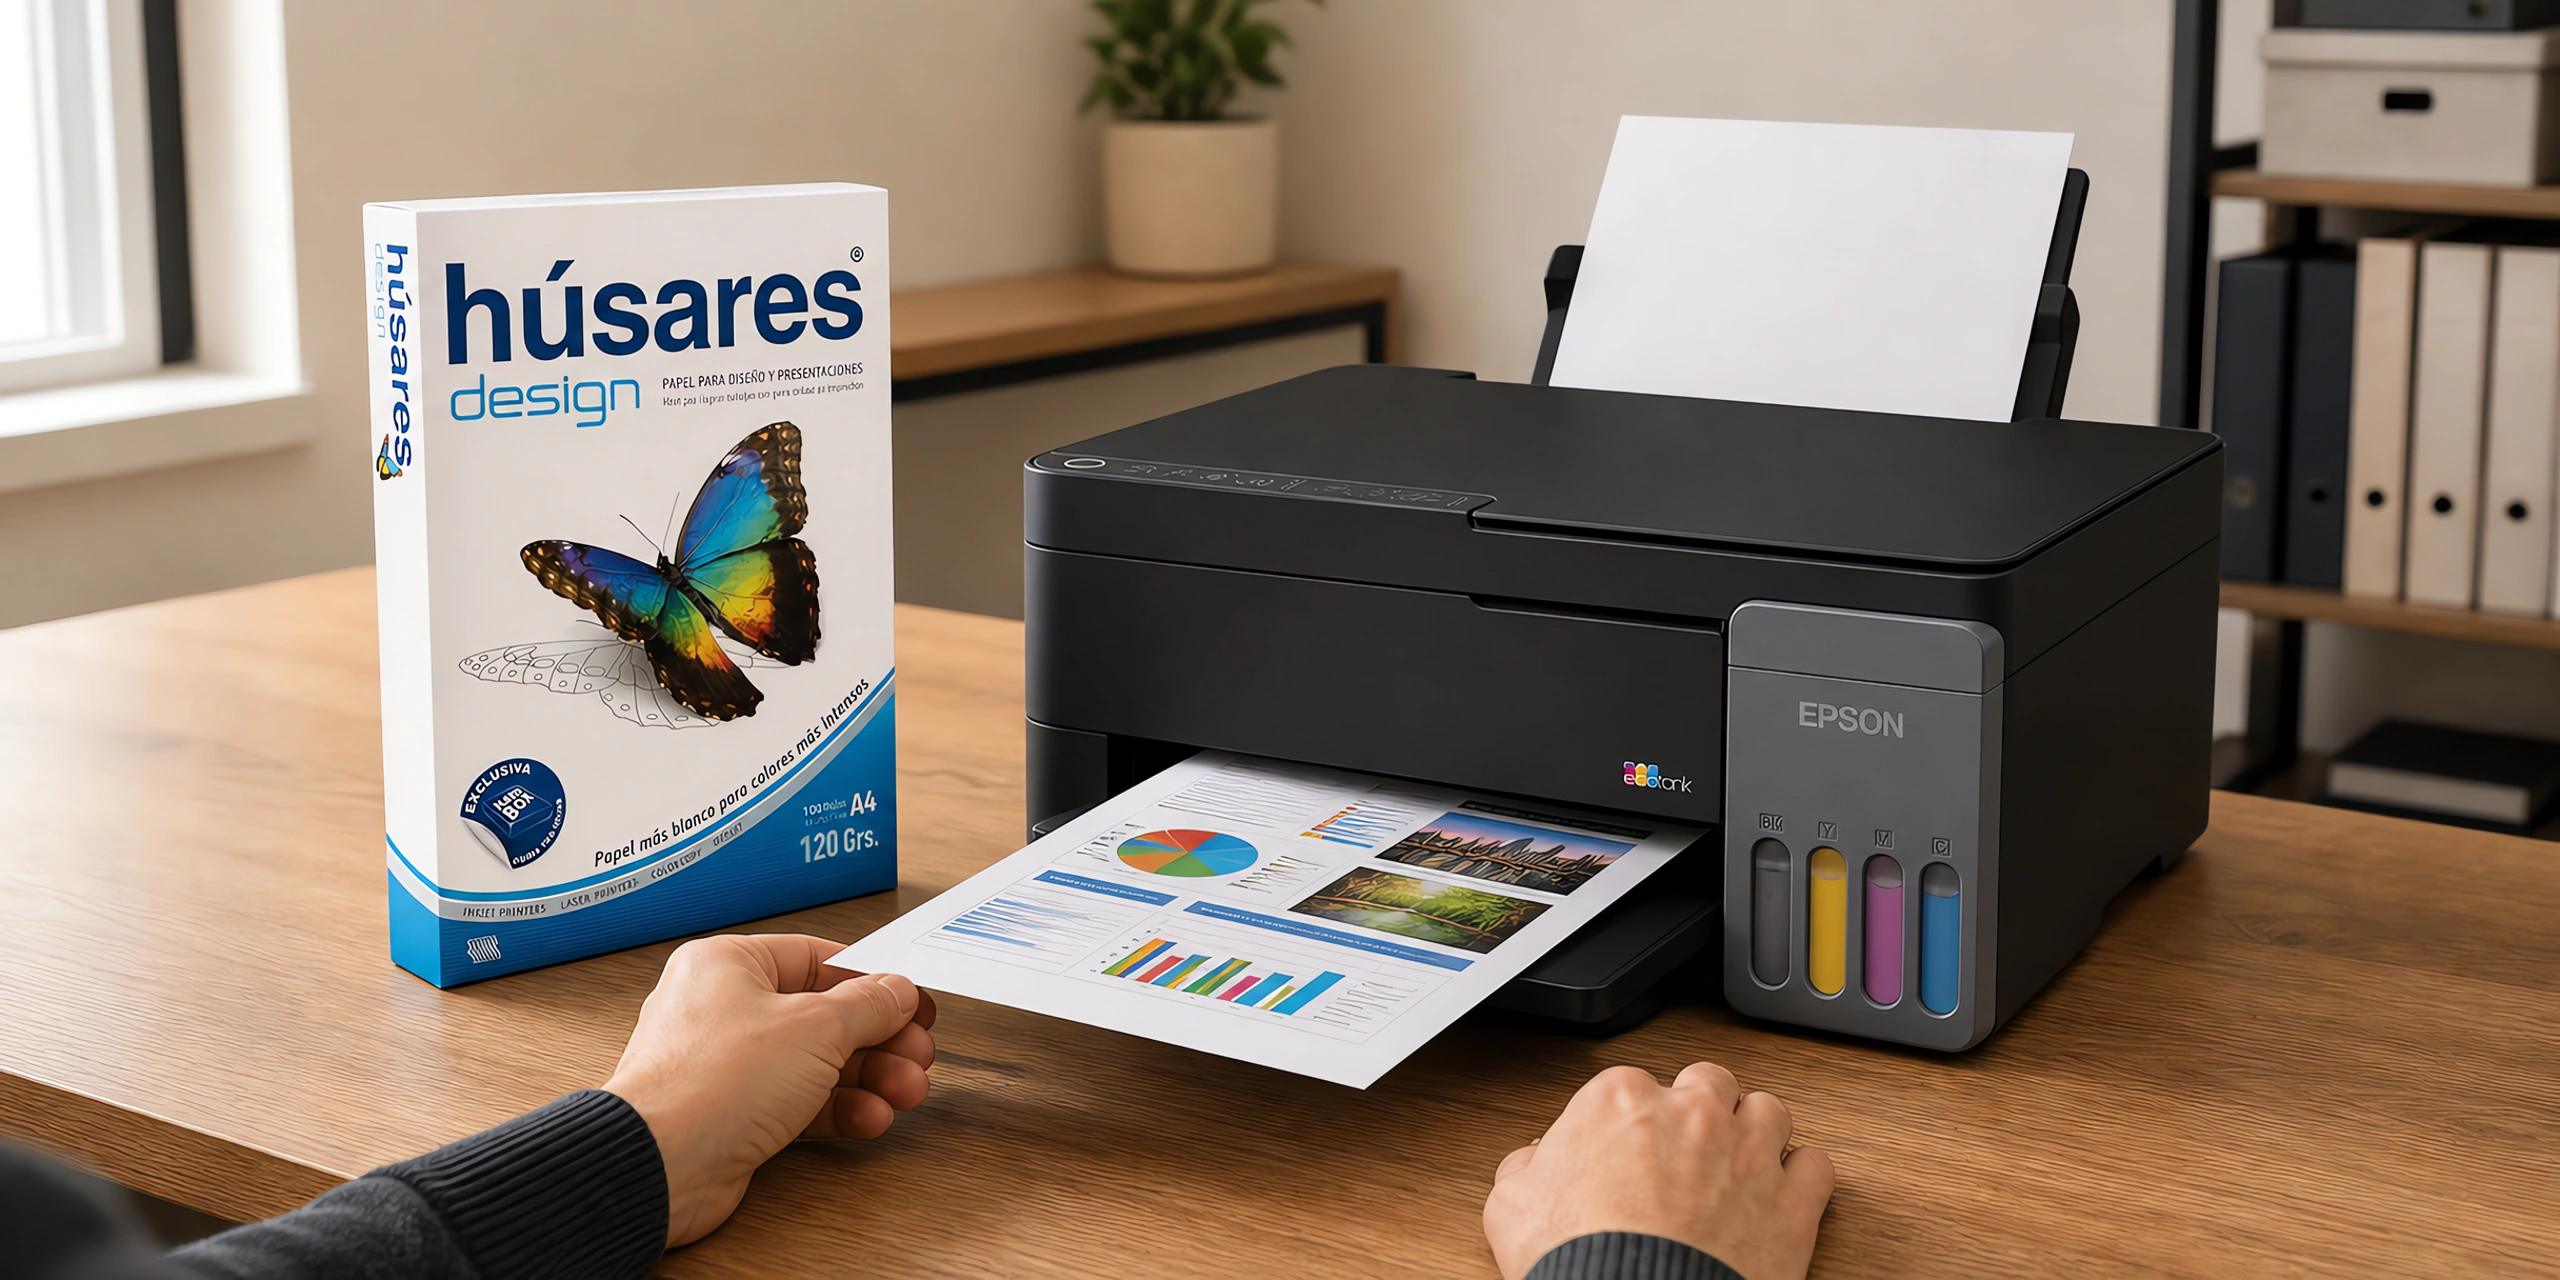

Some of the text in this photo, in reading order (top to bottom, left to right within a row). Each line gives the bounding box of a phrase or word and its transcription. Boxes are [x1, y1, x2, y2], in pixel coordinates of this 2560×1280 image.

[374, 243, 387, 338] design
[445, 259, 864, 365] húsares
[386, 244, 413, 467] húsares
[662, 362, 864, 390] PAPEL PARA DISEÑO Y PRESENTACIONES
[450, 374, 641, 428] design
[1799, 700, 1904, 739] EPSON
[465, 762, 531, 814] EXCLUSIVA
[501, 791, 535, 821] BOX
[594, 839, 635, 867] Papel
[639, 828, 668, 852] más
[672, 804, 716, 838] blanco
[718, 784, 748, 815] para
[751, 749, 796, 790] colores
[796, 728, 822, 753] más
[803, 803, 822, 816] 100
[849, 789, 878, 817] A4
[800, 827, 879, 864] 120 Grs.
